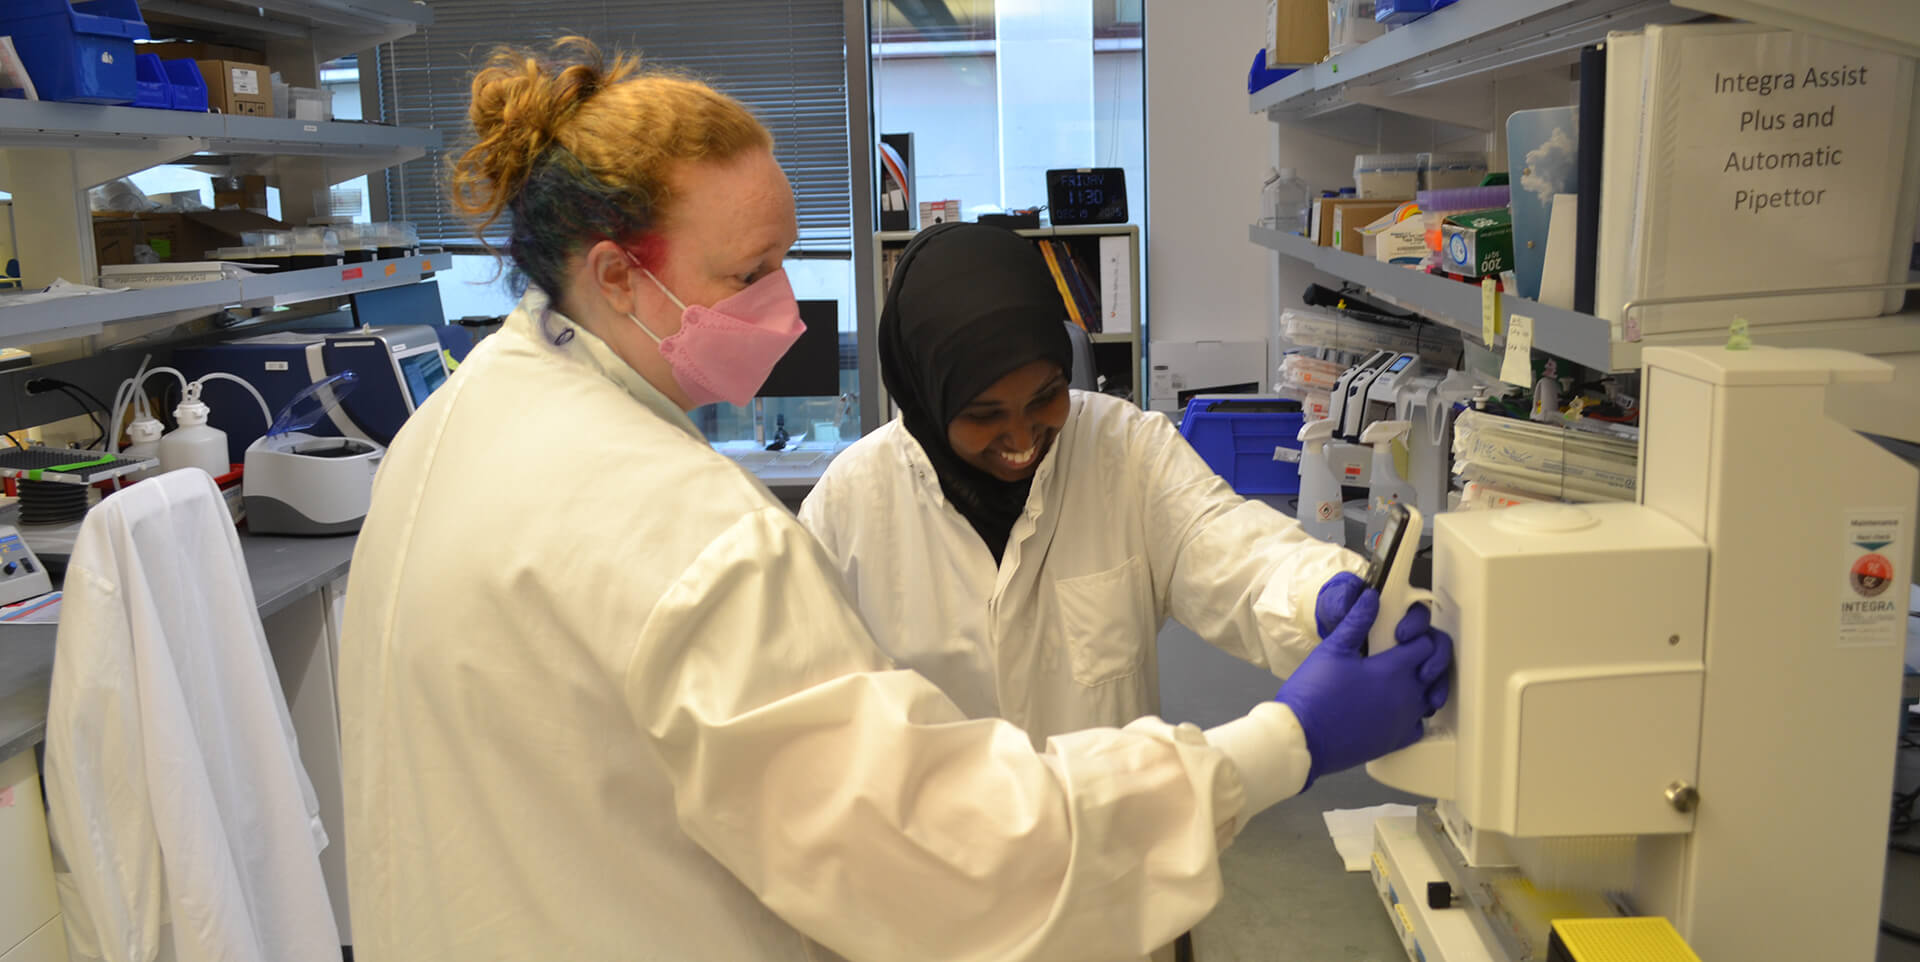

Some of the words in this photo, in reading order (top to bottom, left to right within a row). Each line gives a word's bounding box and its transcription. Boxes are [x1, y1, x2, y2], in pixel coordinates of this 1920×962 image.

[1715, 72, 1795, 96] Integra
[1802, 65, 1868, 88] Assist
[1740, 109, 1786, 132] Plus
[1792, 105, 1835, 129] and
[1724, 145, 1843, 173] Automatic
[1734, 188, 1826, 214] Pipettor
[1481, 257, 1502, 273] 200
[1841, 600, 1896, 612] INTEGRA
